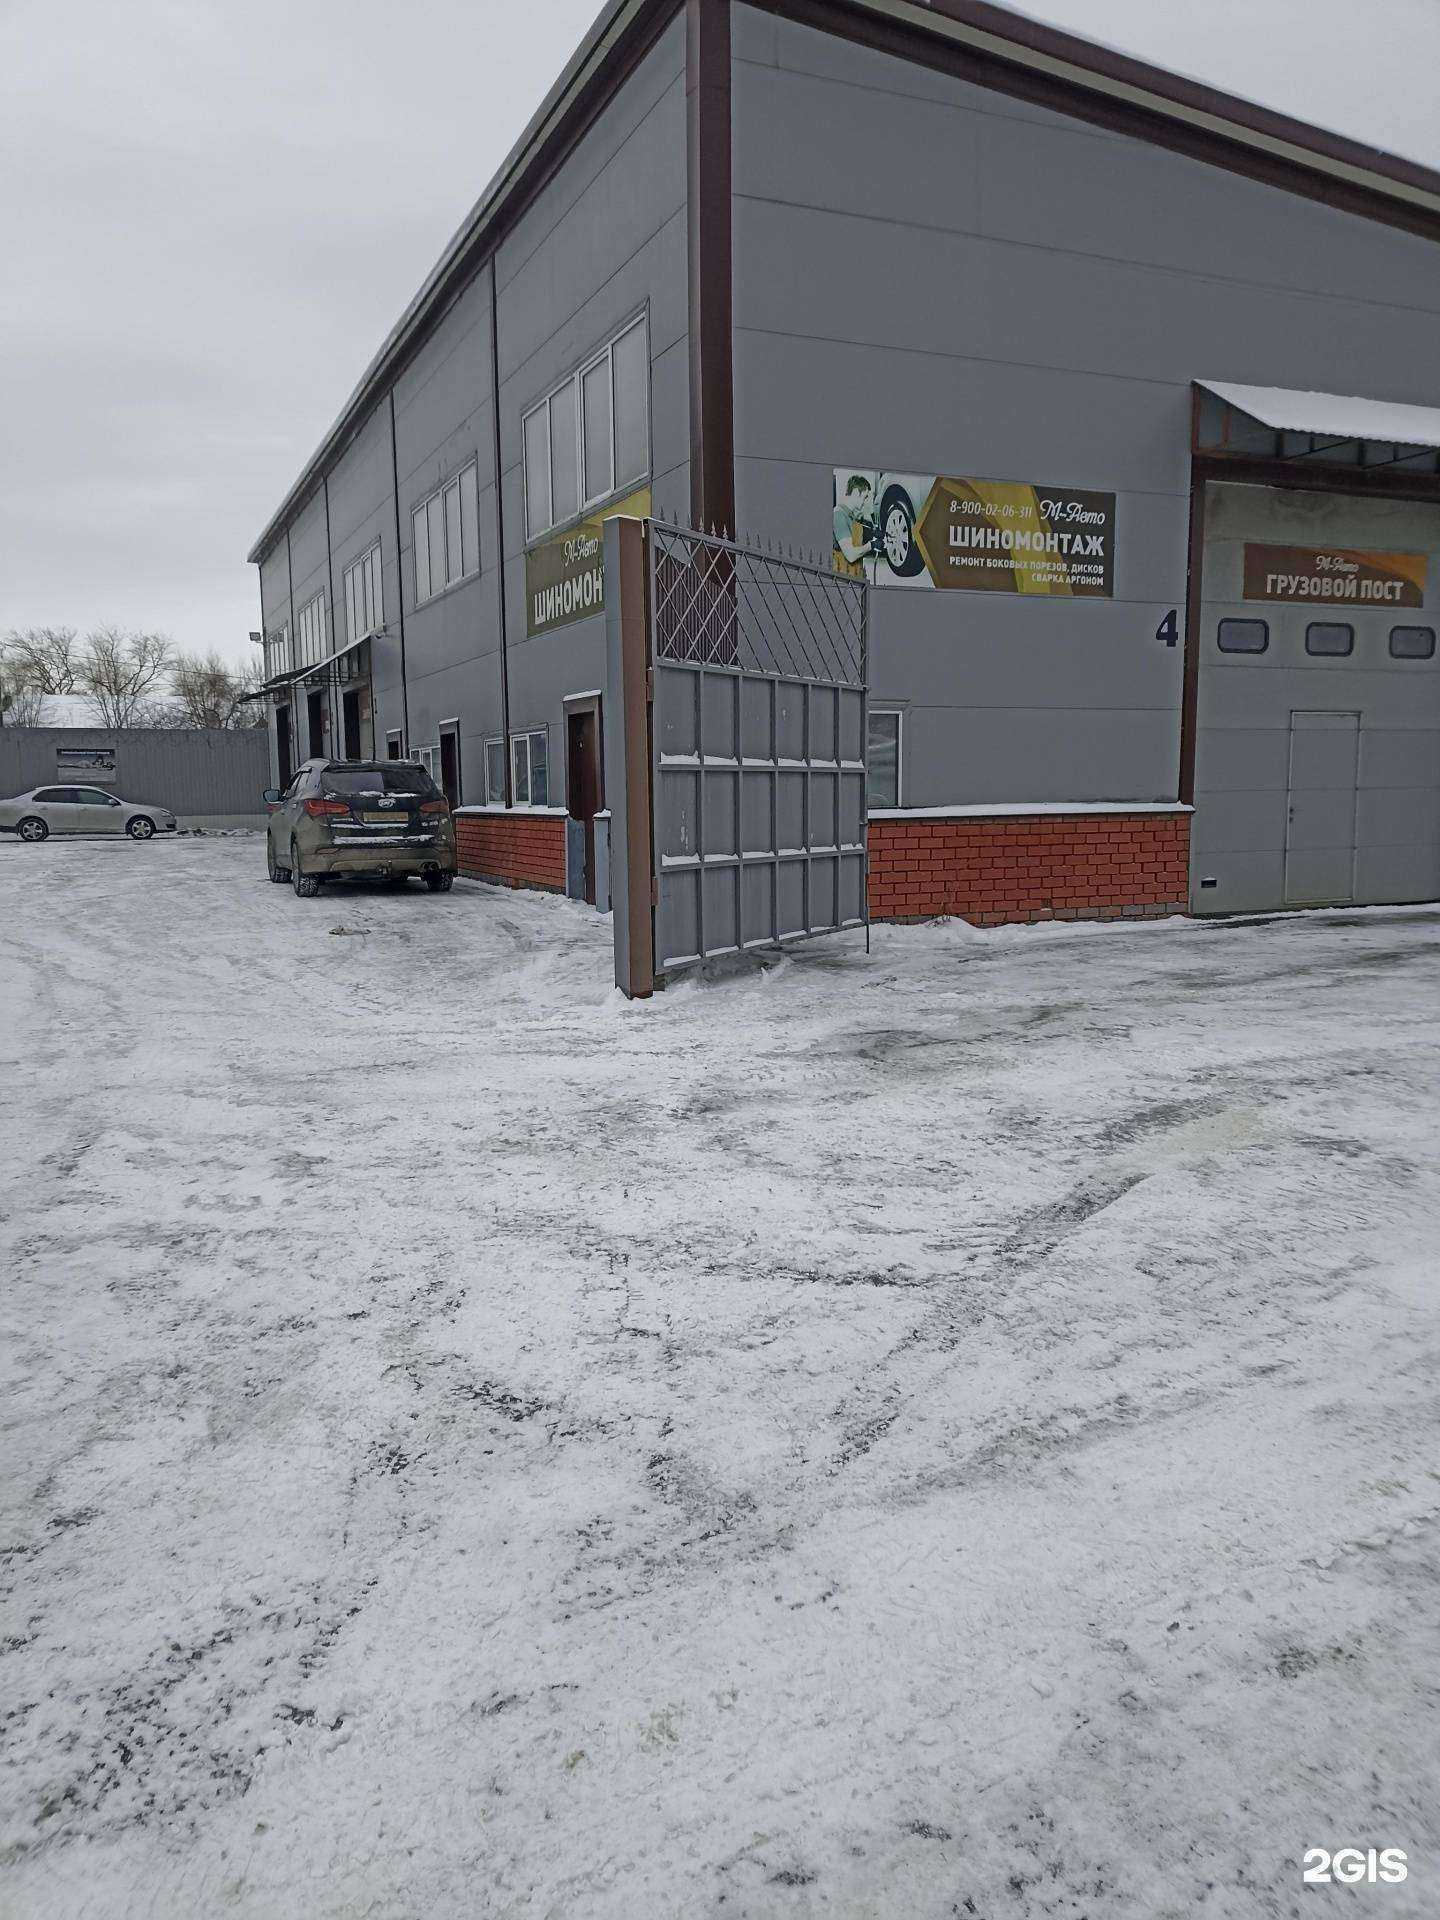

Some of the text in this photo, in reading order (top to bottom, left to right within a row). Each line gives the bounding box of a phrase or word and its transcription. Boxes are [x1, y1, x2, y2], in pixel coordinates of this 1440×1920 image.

[949, 526, 1104, 557] ШИНОМОНТАЖ
[949, 556, 1104, 575] РЕМОНТ БОКОВЫХ ПОРЕЗОВ, ДИСКОВ
[1031, 573, 1104, 586] СВАРКА АРГОНОМ
[534, 566, 605, 625] ШИНОМОН
[1266, 574, 1404, 601] ГРУЗОВОЙ ПОСТ
[1155, 609, 1179, 648] 4
